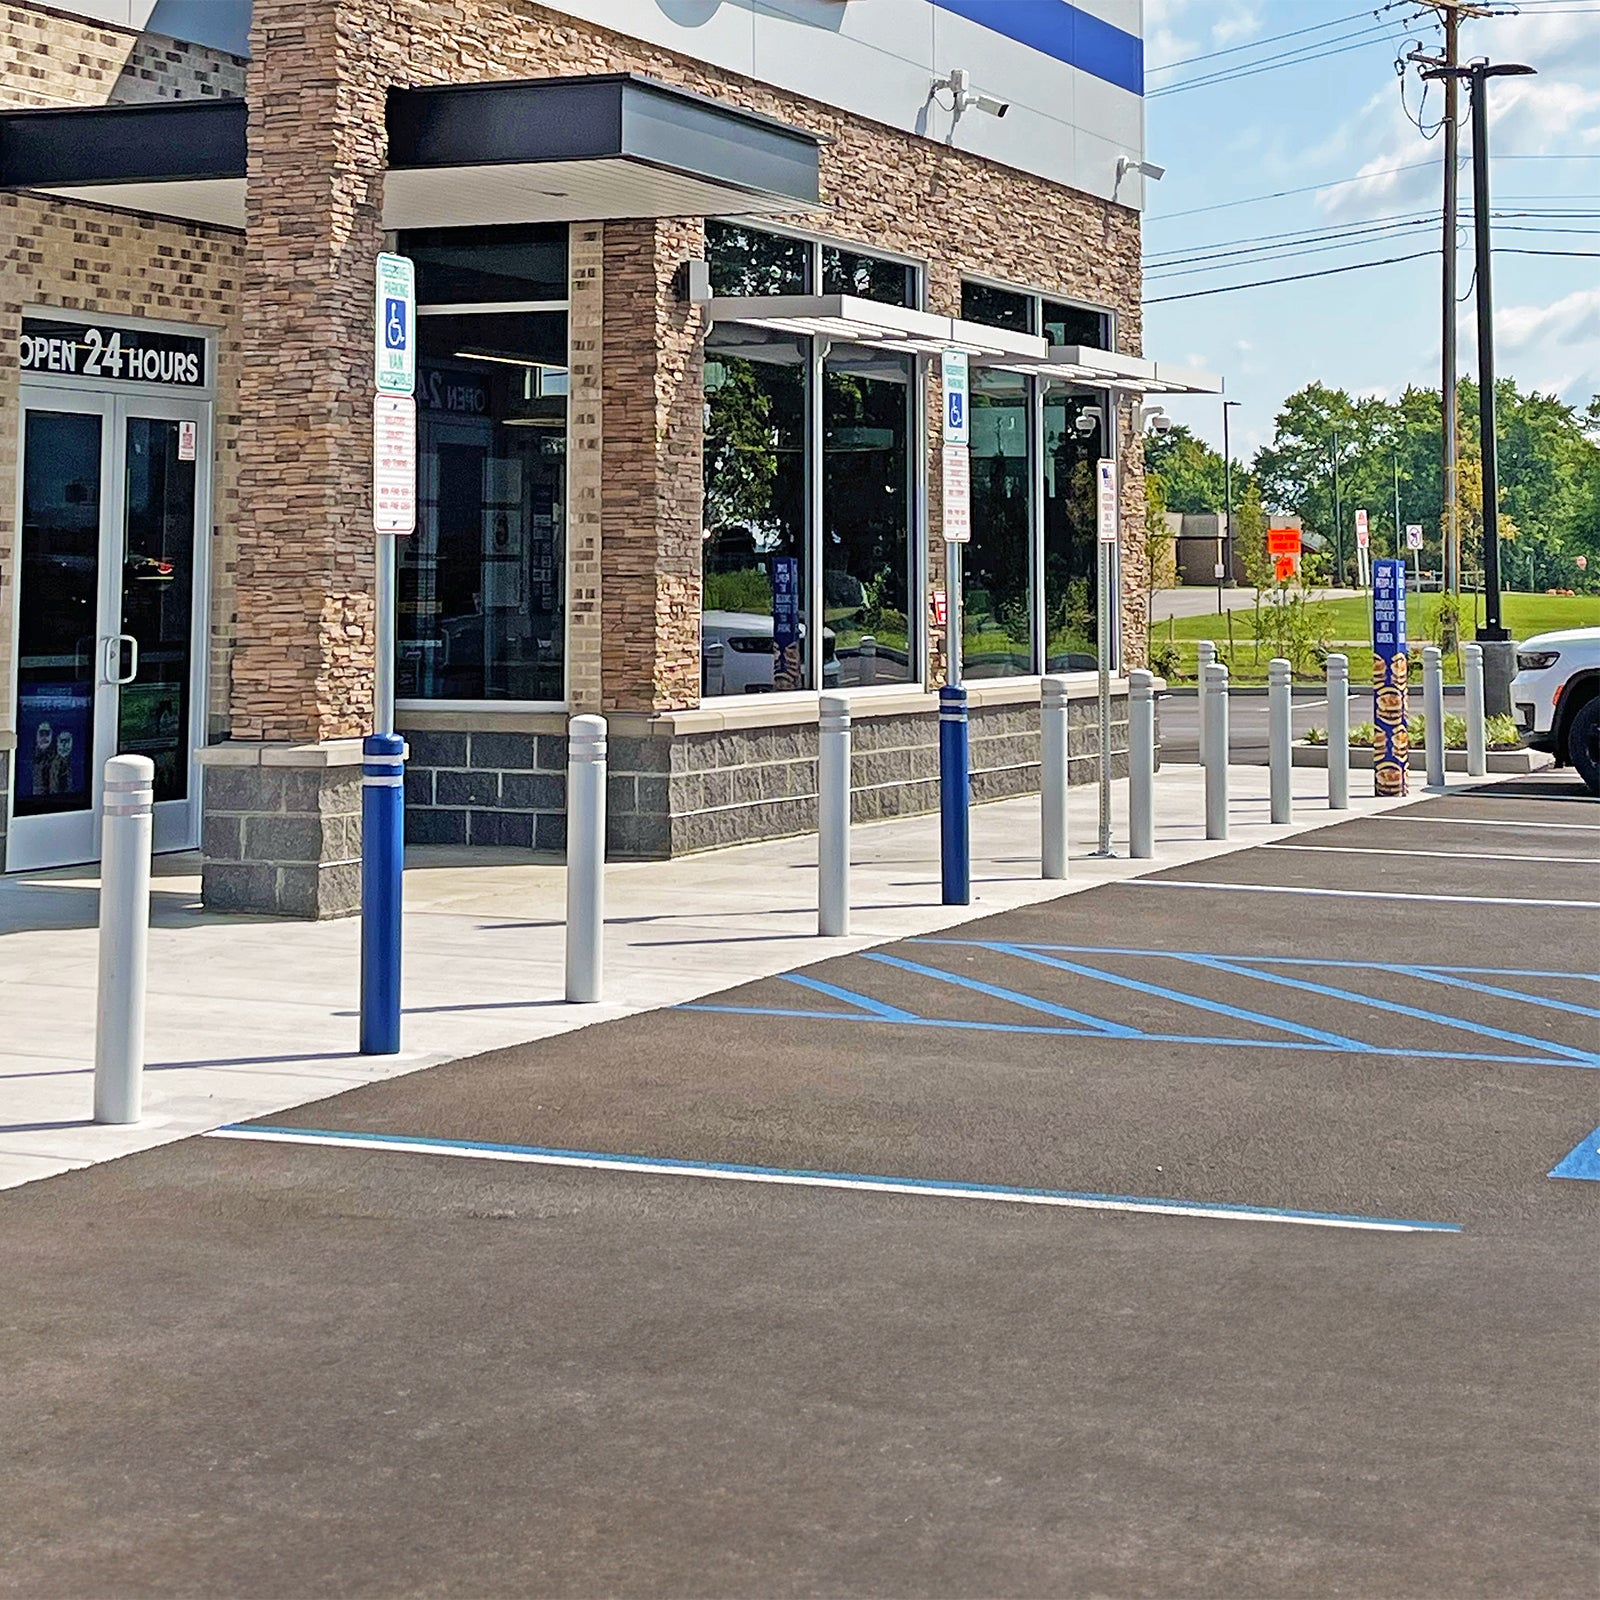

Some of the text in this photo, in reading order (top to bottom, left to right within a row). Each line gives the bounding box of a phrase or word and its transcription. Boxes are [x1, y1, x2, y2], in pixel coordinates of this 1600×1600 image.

[20, 328, 199, 383] OPEN 24 HOURS
